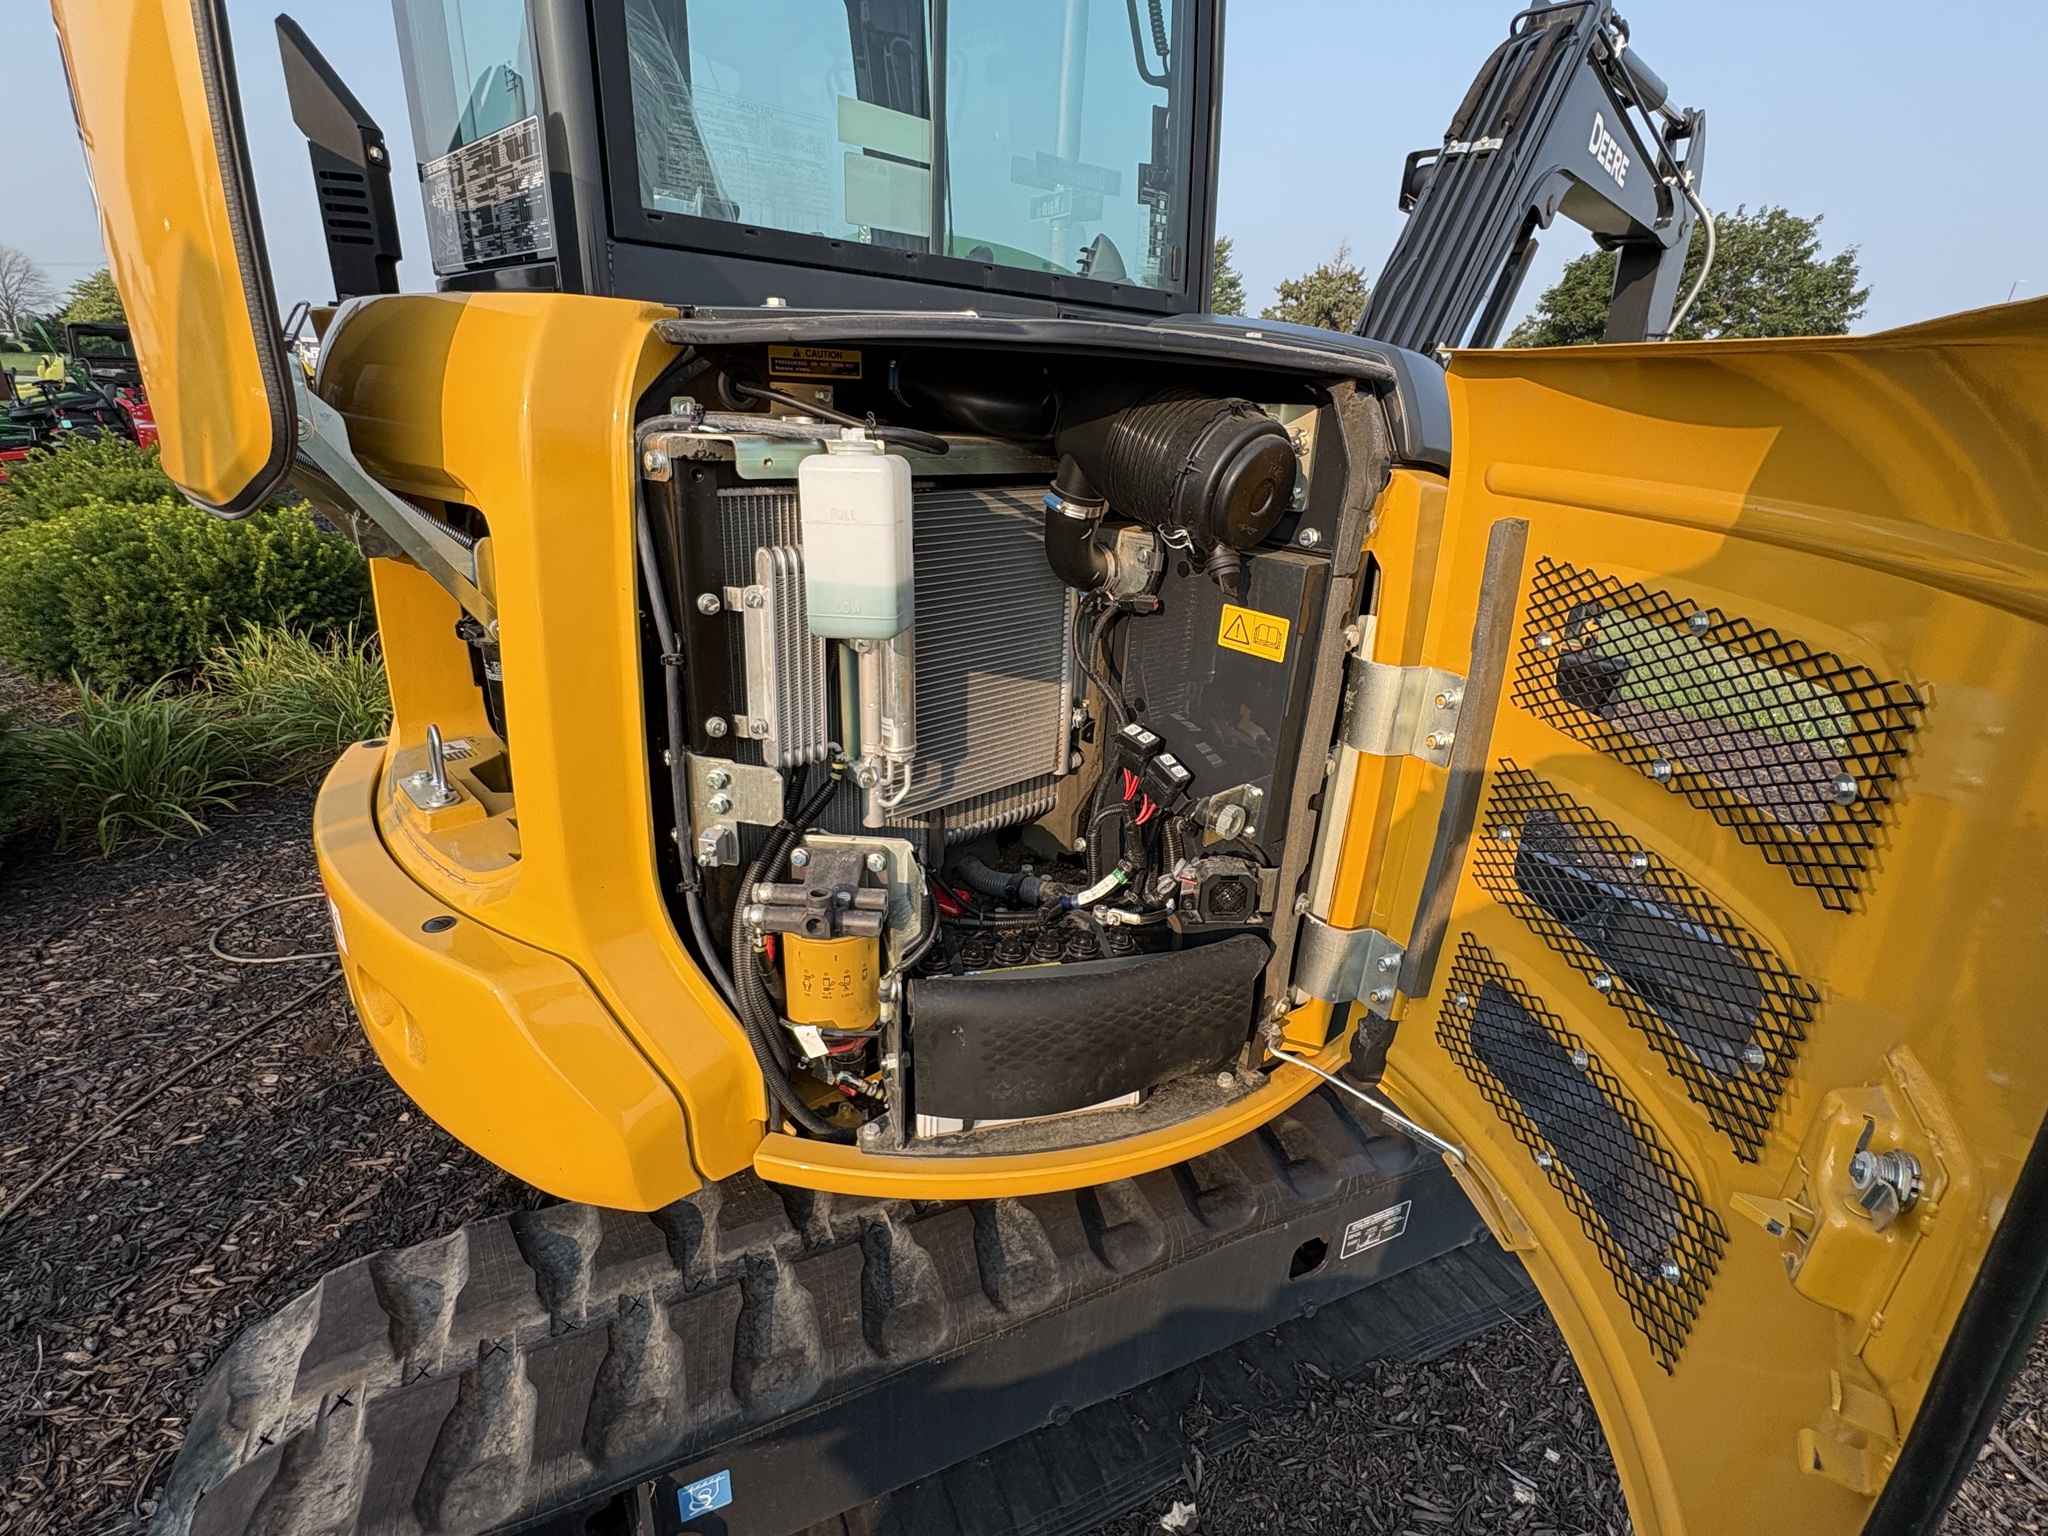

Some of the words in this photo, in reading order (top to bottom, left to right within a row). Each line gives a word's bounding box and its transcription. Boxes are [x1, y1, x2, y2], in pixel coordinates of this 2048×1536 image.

[1588, 111, 1631, 189] DEERE
[805, 349, 843, 360] CAUTION
[830, 508, 857, 522] FULL
[836, 602, 863, 614] LOW
